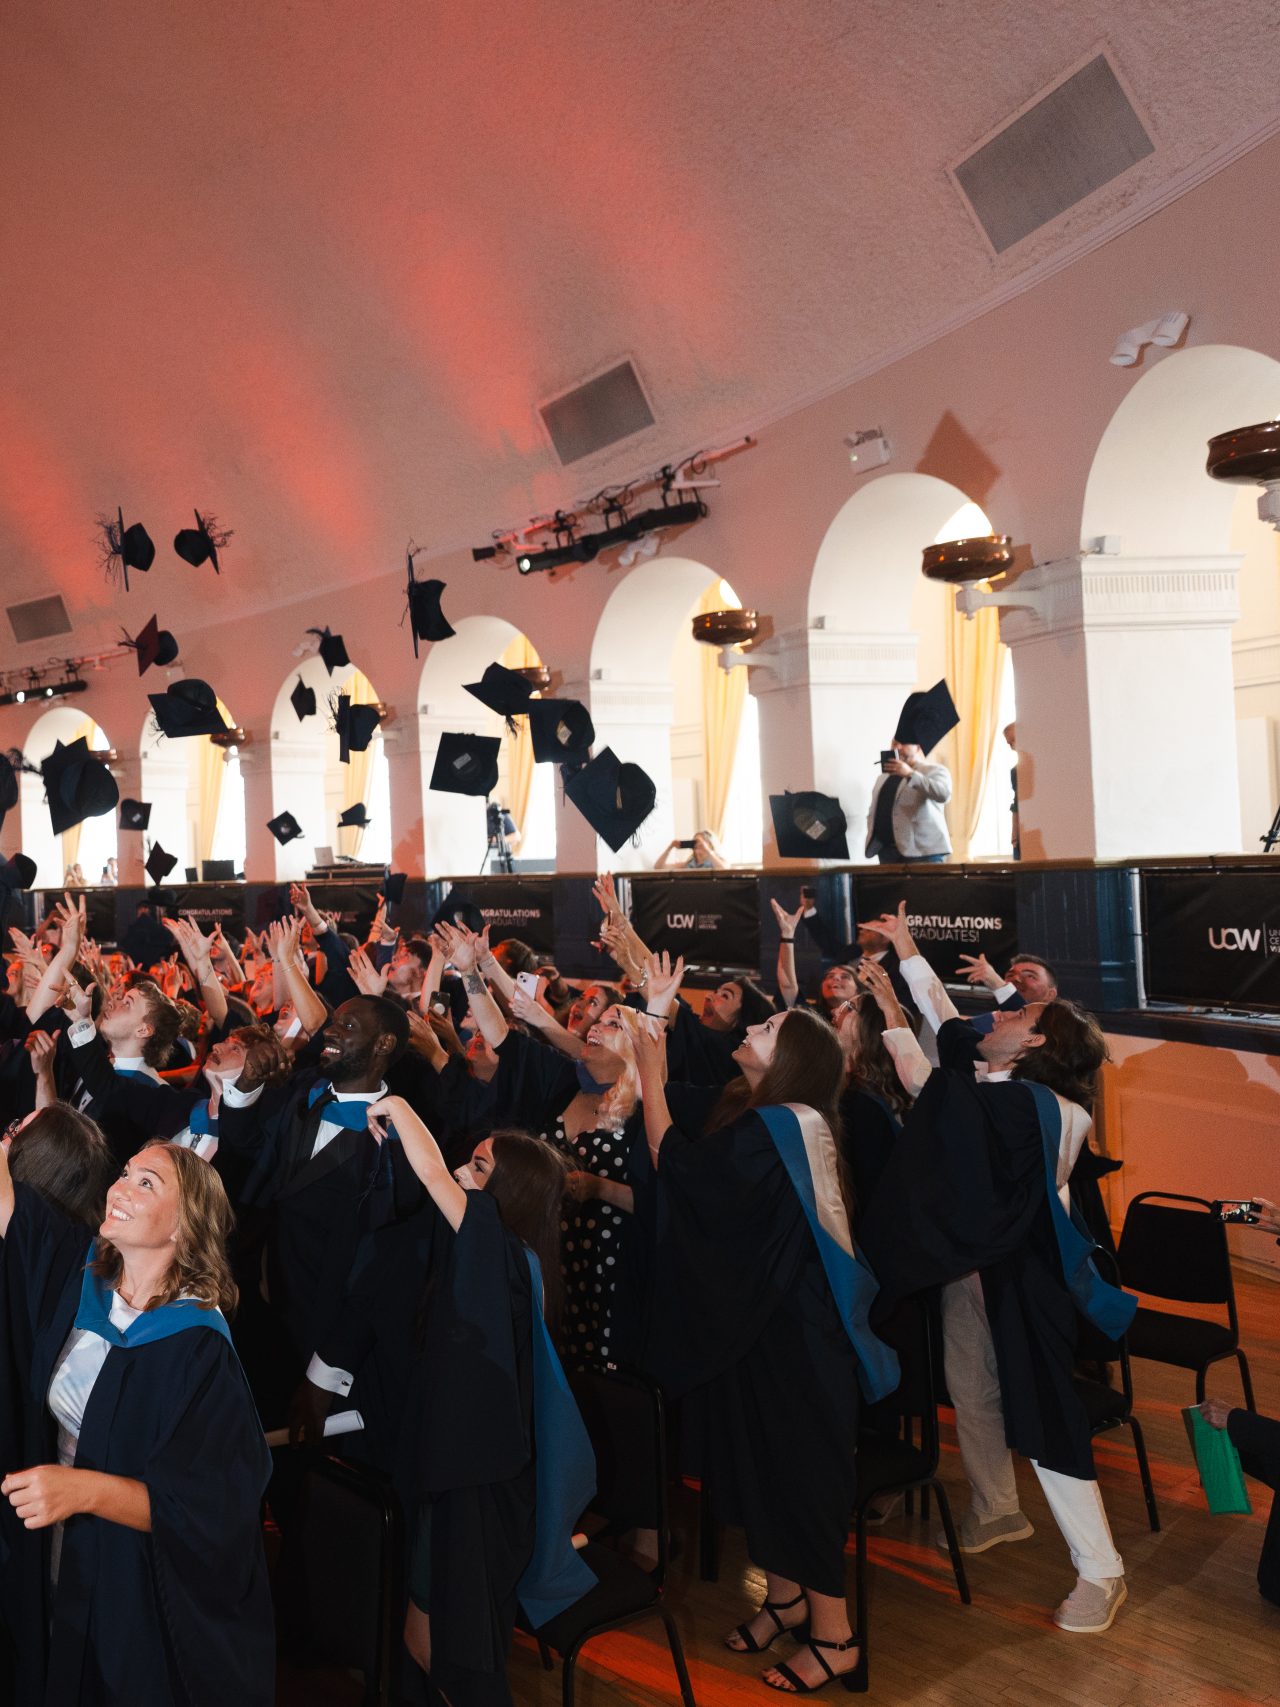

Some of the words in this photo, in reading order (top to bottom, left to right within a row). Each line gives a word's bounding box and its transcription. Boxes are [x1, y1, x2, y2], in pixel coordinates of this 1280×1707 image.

[479, 908, 541, 918] NGRATULATIONS
[666, 913, 695, 929] UCW
[905, 914, 1003, 930] GRATULATIONS
[910, 927, 980, 943] RADUATES!
[1208, 927, 1261, 952] UCW
